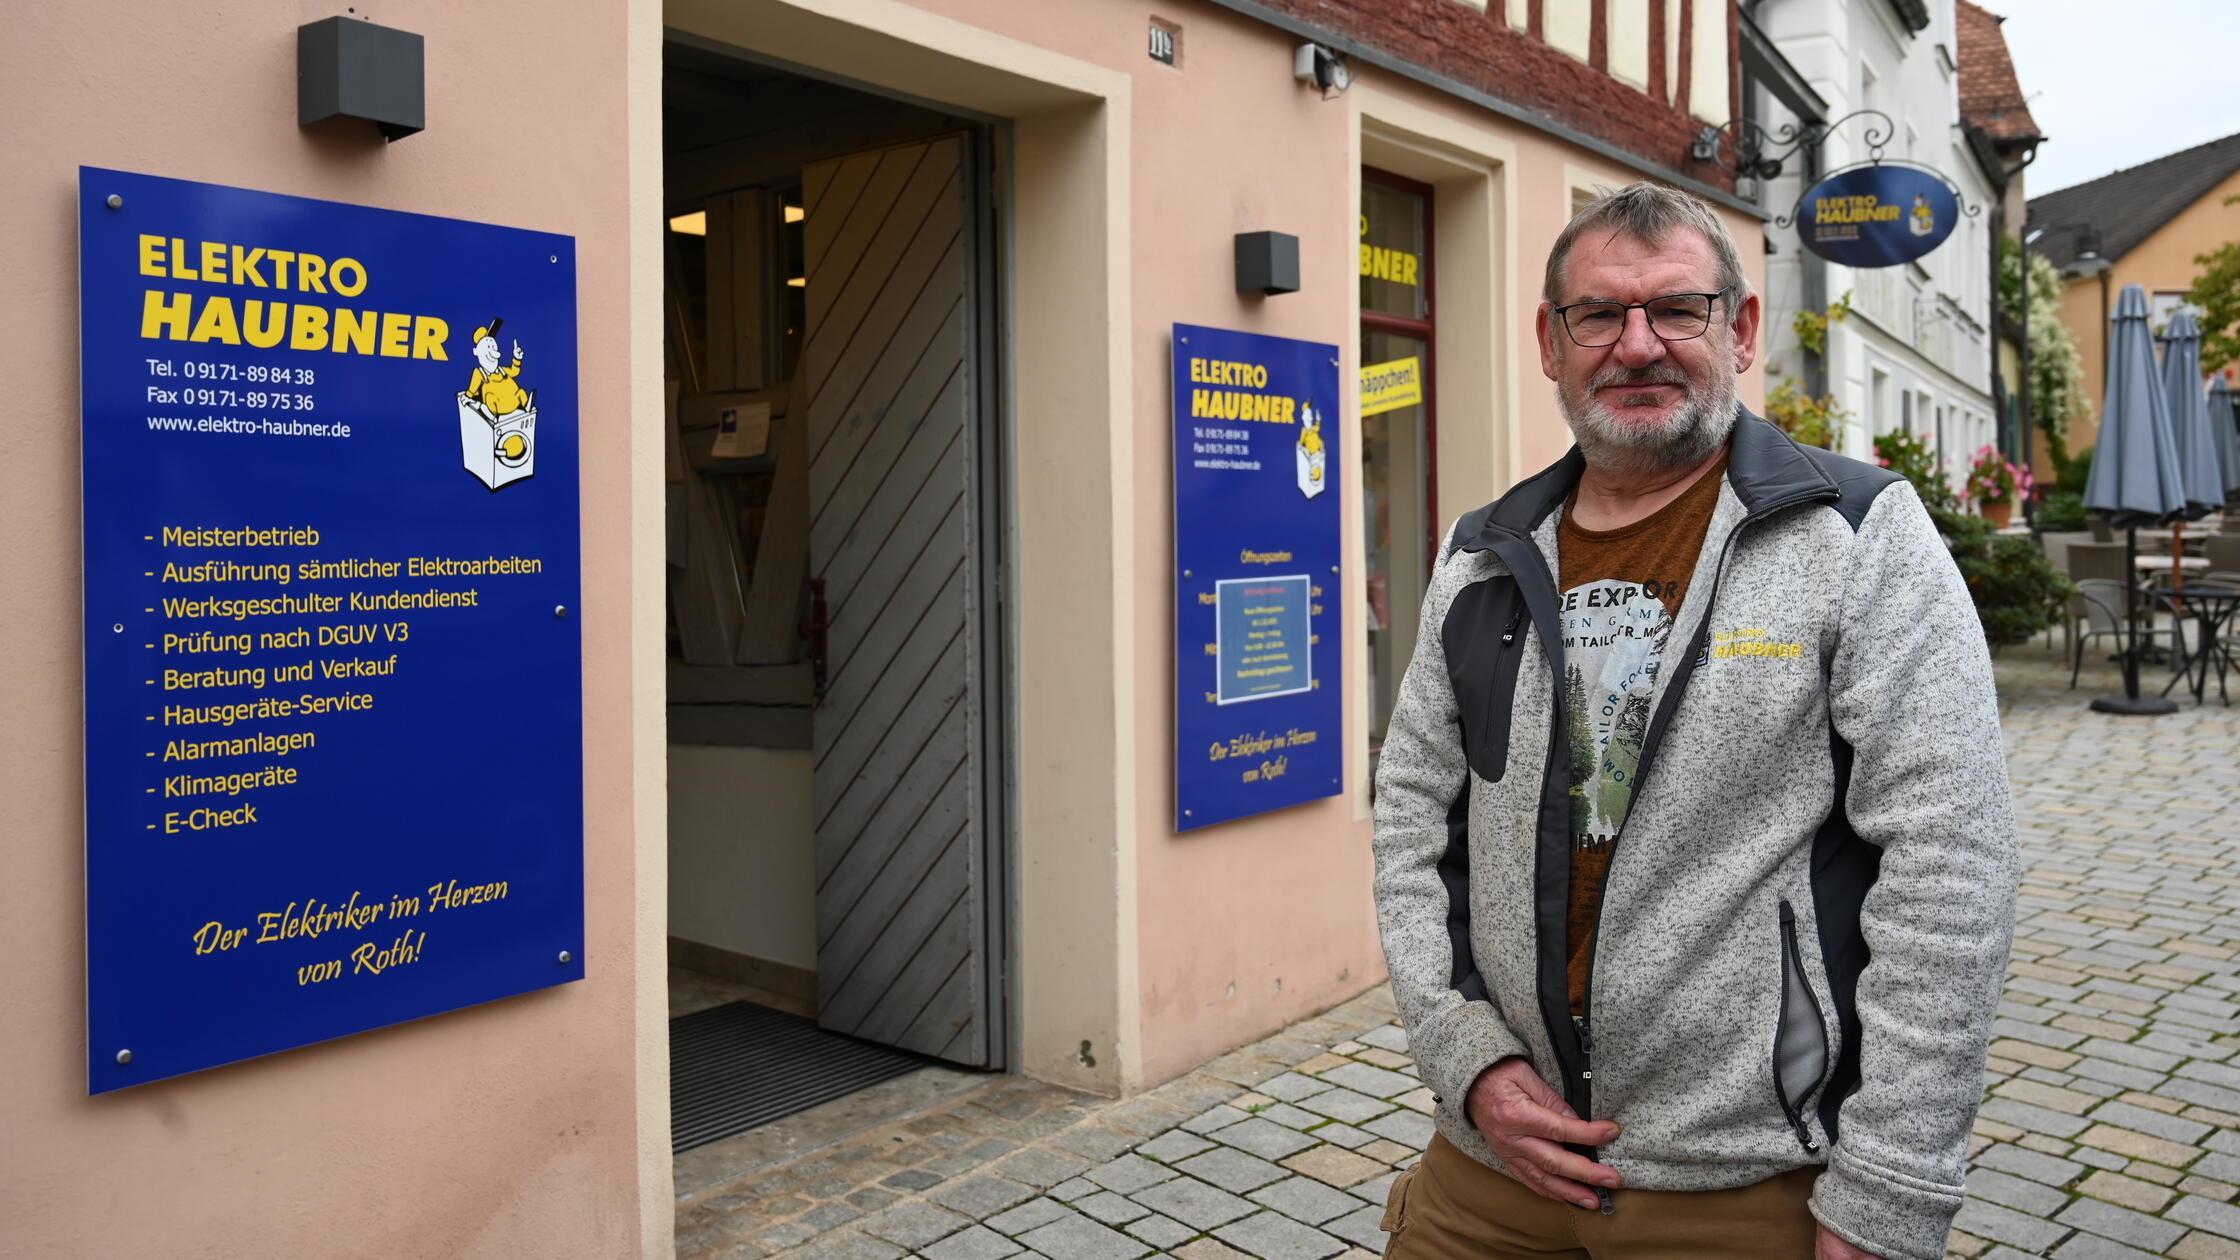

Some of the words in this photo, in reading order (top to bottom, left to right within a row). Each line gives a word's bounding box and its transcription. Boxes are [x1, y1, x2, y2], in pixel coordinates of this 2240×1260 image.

[1816, 206, 1900, 224] HAUBNER
[140, 234, 367, 297] ELEKTRO
[141, 290, 449, 360] HAUBNER
[146, 359, 177, 376] Tel.
[1191, 358, 1267, 388] ELEKTRO
[147, 386, 177, 404] Fax
[1192, 389, 1295, 424] HAUBNER
[147, 416, 350, 437] www.elektro-haubner.de
[162, 526, 319, 547] Meisterbetrieb
[162, 561, 291, 585] Ausführung
[298, 557, 401, 581] sämtlicher
[407, 555, 542, 577] Elektroarbeiten
[163, 593, 343, 621] Werksgeschulter
[350, 588, 478, 612] Kundendienst
[1587, 580, 1679, 607] EXPOR
[163, 631, 252, 656] Prüfung
[260, 627, 310, 648] nach
[318, 623, 377, 646] DGUV
[384, 622, 409, 642] V3
[164, 666, 266, 690] Beratung
[274, 660, 313, 683] und
[321, 655, 398, 679] Verkauf
[164, 691, 373, 727] Hausgeräte-Service
[164, 729, 315, 762] Alarmanlagen
[164, 765, 297, 799] Klimageräte
[164, 804, 257, 834] E-Check
[193, 920, 248, 956] Der
[256, 891, 384, 945] Elektriker
[388, 895, 420, 920] im
[428, 879, 509, 914] Herzen
[298, 957, 342, 987] von
[350, 928, 425, 975] Roth!
